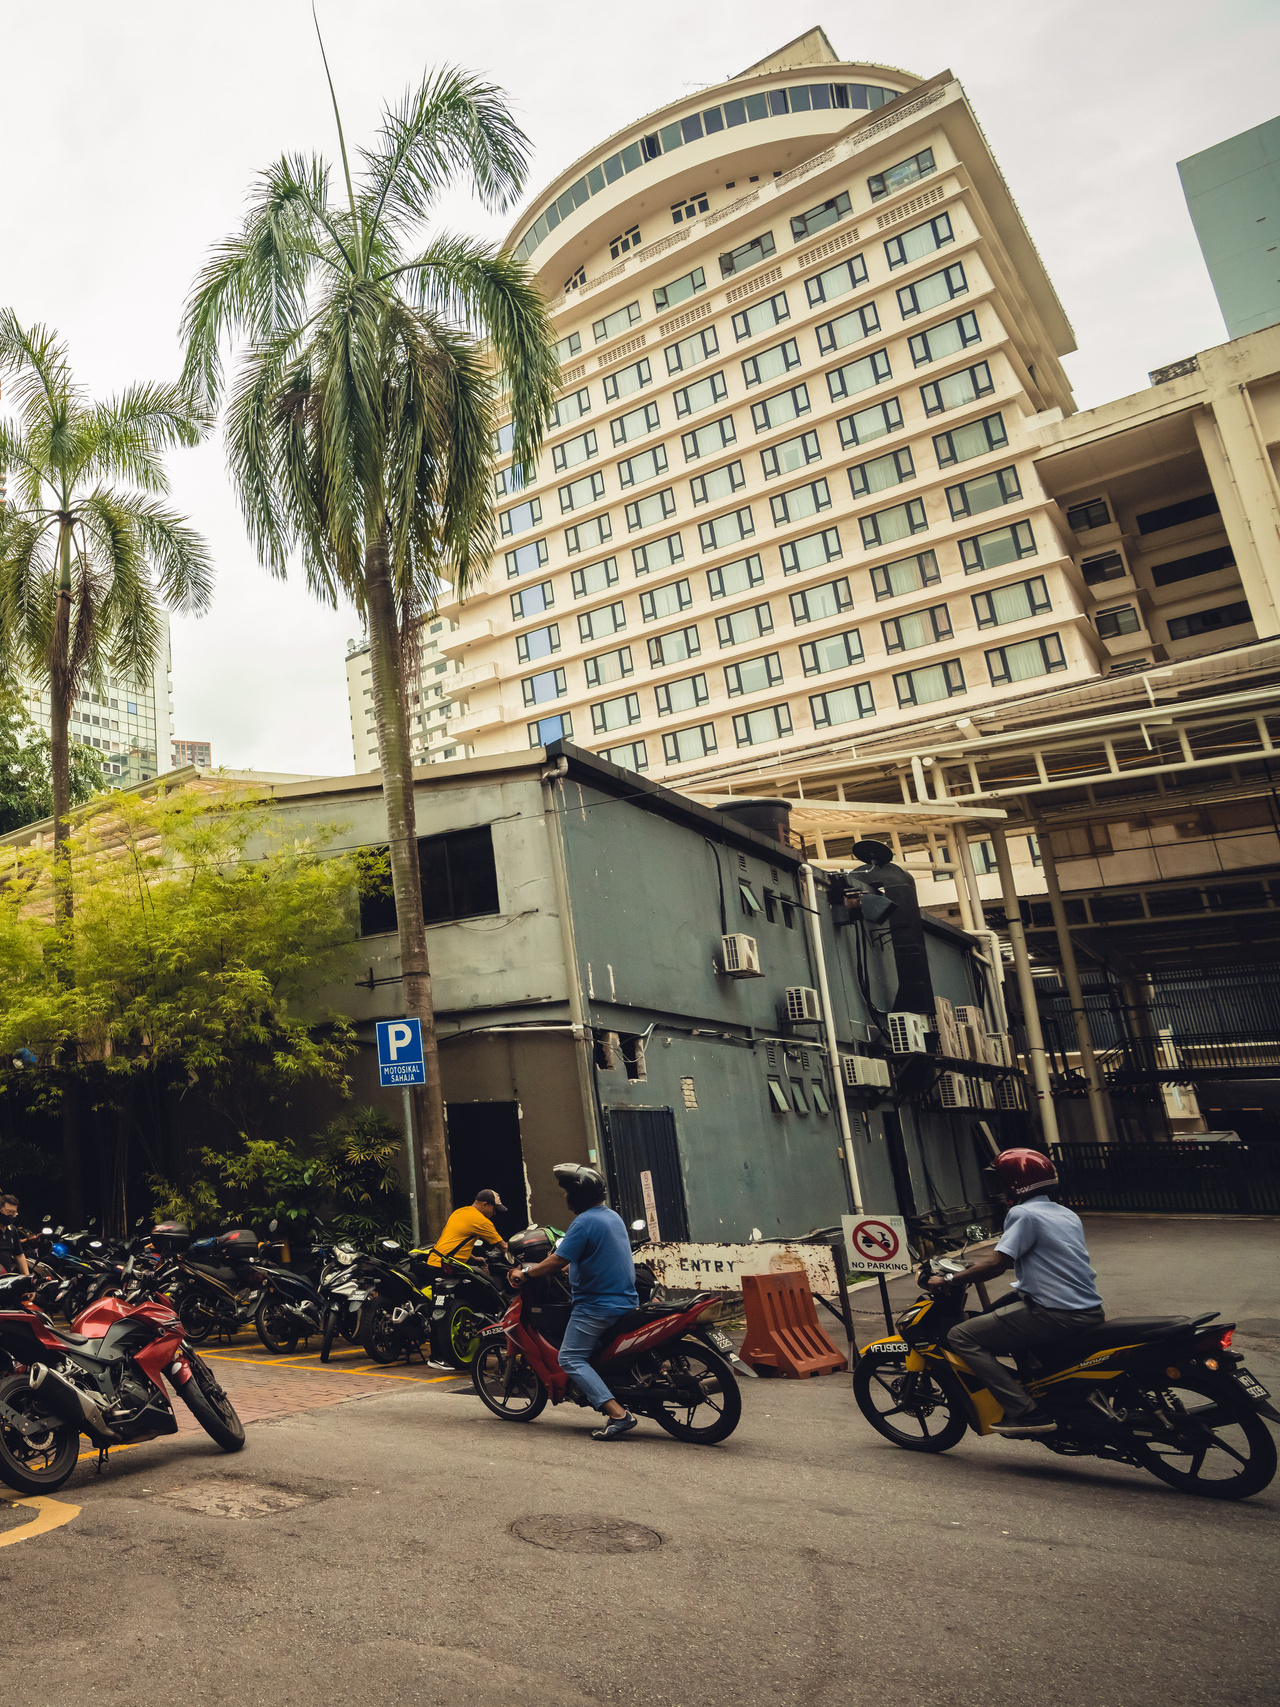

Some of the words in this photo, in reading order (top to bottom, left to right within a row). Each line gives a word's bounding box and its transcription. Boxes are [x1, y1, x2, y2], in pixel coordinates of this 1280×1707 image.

[388, 1023, 412, 1060] P
[384, 1065, 420, 1075] MOTOSIKAL
[391, 1074, 415, 1083] SAHAJA
[679, 1257, 735, 1273] ENTRY
[852, 1261, 865, 1269] NO
[867, 1262, 908, 1271] PARKING
[870, 1343, 909, 1353] VFU9038
